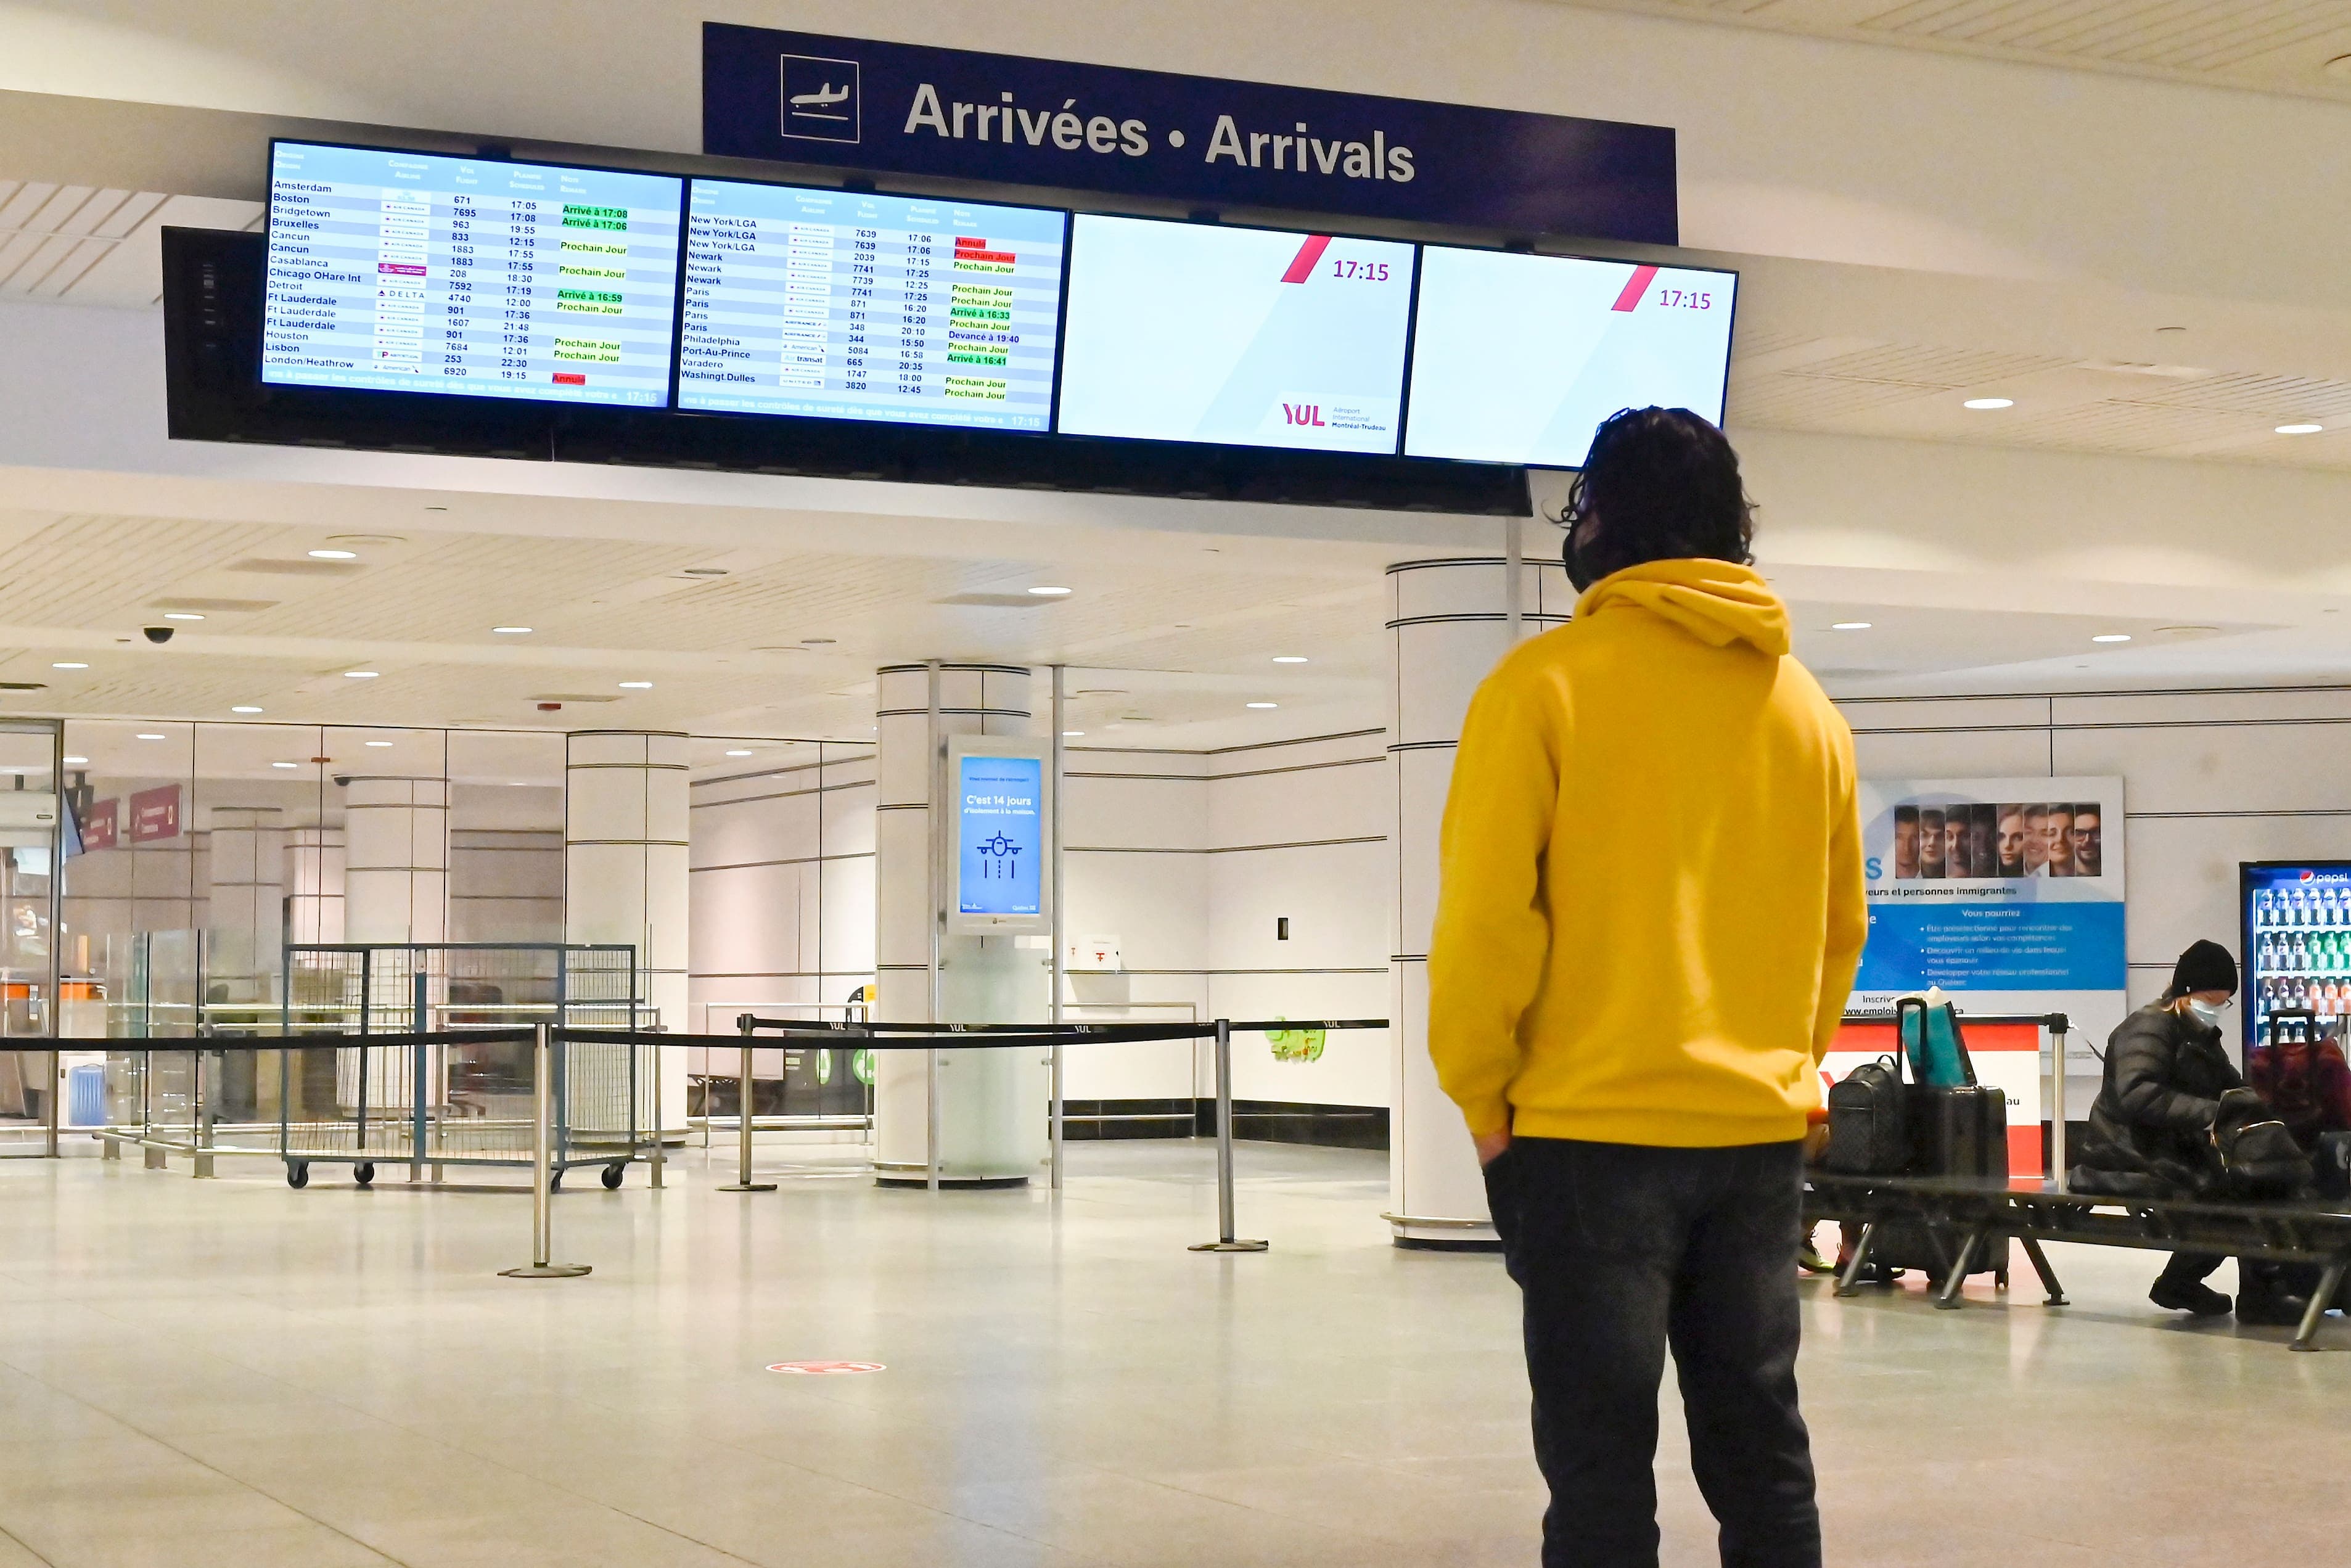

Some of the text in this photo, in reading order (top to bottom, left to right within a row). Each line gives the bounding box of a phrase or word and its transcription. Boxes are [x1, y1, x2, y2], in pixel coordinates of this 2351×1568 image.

[904, 83, 1416, 183] Arrivées Arrivals
[274, 180, 331, 192] Amsterdam
[273, 192, 310, 203] Boston
[453, 195, 470, 204] 671
[511, 200, 536, 210] 17:05
[273, 205, 330, 218] Bridgetown
[453, 207, 476, 217] 7695
[562, 205, 591, 215] Arrivé
[603, 208, 628, 218] 17:08
[511, 212, 536, 222] 17:08
[690, 215, 757, 228] New York/LGA
[271, 217, 319, 229] Bruxelles
[452, 220, 469, 229] 963
[561, 217, 591, 227] Arrivé
[602, 220, 627, 230] 17:06
[510, 225, 535, 234] 19:55
[689, 227, 756, 240] New York/LGA
[856, 229, 876, 238] 7639
[271, 230, 310, 240] Cancun
[451, 232, 469, 241] 833
[908, 234, 931, 243] 17:06
[509, 237, 534, 247] 12:15
[689, 239, 755, 252] New York/LGA
[855, 240, 876, 250] 7639
[270, 242, 309, 253] Cancun
[560, 241, 626, 254] Prochain Jour
[908, 245, 930, 255] 17:06
[509, 249, 533, 258] 17:55
[688, 250, 723, 261] Newark
[853, 252, 875, 261] 2039
[269, 255, 328, 267] Casablanca
[451, 257, 473, 266] 1883
[507, 261, 533, 271] 17:55
[907, 257, 930, 266] 17:15
[559, 265, 625, 278] Prochain Jour
[687, 263, 721, 273] Newark
[853, 264, 873, 273] 7741
[953, 261, 1014, 273] Prochain Jour
[1333, 260, 1389, 281] 17:15
[269, 268, 361, 282] Chicago OHare Int
[449, 269, 466, 277] 208
[906, 268, 929, 277] 17:25
[507, 274, 532, 283] 18:30
[686, 274, 721, 285] Newark
[268, 280, 302, 290] Detroit
[449, 281, 472, 290] 7592
[506, 285, 531, 295] 17:19
[951, 284, 1012, 296] Prochain Jour
[388, 290, 425, 299] DELTA
[557, 289, 586, 300] Arrivé
[597, 293, 622, 302] 16:59
[686, 286, 710, 296] Paris
[851, 287, 872, 297] 7741
[268, 292, 337, 305] Ft Lauderdale
[448, 293, 471, 303] 4740
[904, 292, 927, 301] 17:25
[951, 295, 1011, 308] Prochain Jour
[1660, 289, 1711, 310] 17:15
[506, 298, 531, 307] 12:00
[685, 298, 709, 308] Paris
[267, 305, 336, 318] Ft Lauderdale
[447, 305, 464, 314] 901
[556, 302, 622, 314] Prochain Jour
[950, 307, 977, 317] Arrivé
[987, 310, 1010, 319] 16:33
[504, 310, 530, 319] 17:36
[684, 310, 708, 319] Paris
[850, 311, 864, 319] 871
[903, 315, 925, 324] 16:20
[266, 317, 335, 330] Ft Lauderdale
[448, 318, 469, 327] 1607
[684, 322, 707, 332] Paris
[949, 319, 1010, 330] Prochain Jour
[266, 330, 308, 340] Houston
[446, 330, 462, 339] 901
[503, 334, 528, 343] 17:36
[848, 334, 864, 343] 344
[948, 330, 986, 340] Devancé
[997, 334, 1019, 343] 19:40
[554, 337, 620, 350] Prochain Jour
[683, 334, 740, 346] Philadelphia
[901, 339, 924, 347] 15:50
[265, 342, 300, 352] Lisbon
[503, 346, 527, 355] 12:01
[682, 346, 750, 358] Port-Au-Prince
[948, 342, 1008, 353] Prochain Jour
[265, 355, 354, 367] London/Heathrow
[444, 354, 462, 363] 253
[553, 350, 619, 362] Prochain Jour
[796, 355, 823, 363] transat
[946, 353, 974, 363] Arrivé
[983, 356, 1006, 366] 16:41
[501, 358, 527, 367] 22:30
[681, 358, 723, 368] Varadero
[847, 358, 863, 366] 665
[898, 361, 922, 371] 20:35
[443, 366, 467, 376] 6920
[501, 371, 526, 379] 19:15
[681, 369, 755, 382] Washingt.Dulles
[845, 380, 866, 390] 3820
[945, 376, 1006, 388] Prochain Jour
[898, 385, 921, 393] 12:45
[944, 388, 1005, 400] Prochain Jour
[1282, 403, 1325, 427] YUL
[1332, 422, 1386, 431] Montréal-Trudeau
[993, 795, 1005, 805] 14
[1006, 795, 1032, 807] jours
[2316, 872, 2349, 884] pepsi
[1891, 887, 1900, 897] et
[1903, 889, 1954, 898] personnes
[1956, 887, 2017, 897] immigrantes
[1963, 908, 2021, 919] Vous pourriez
[829, 1022, 846, 1030] YUL
[950, 1024, 966, 1032] YUL
